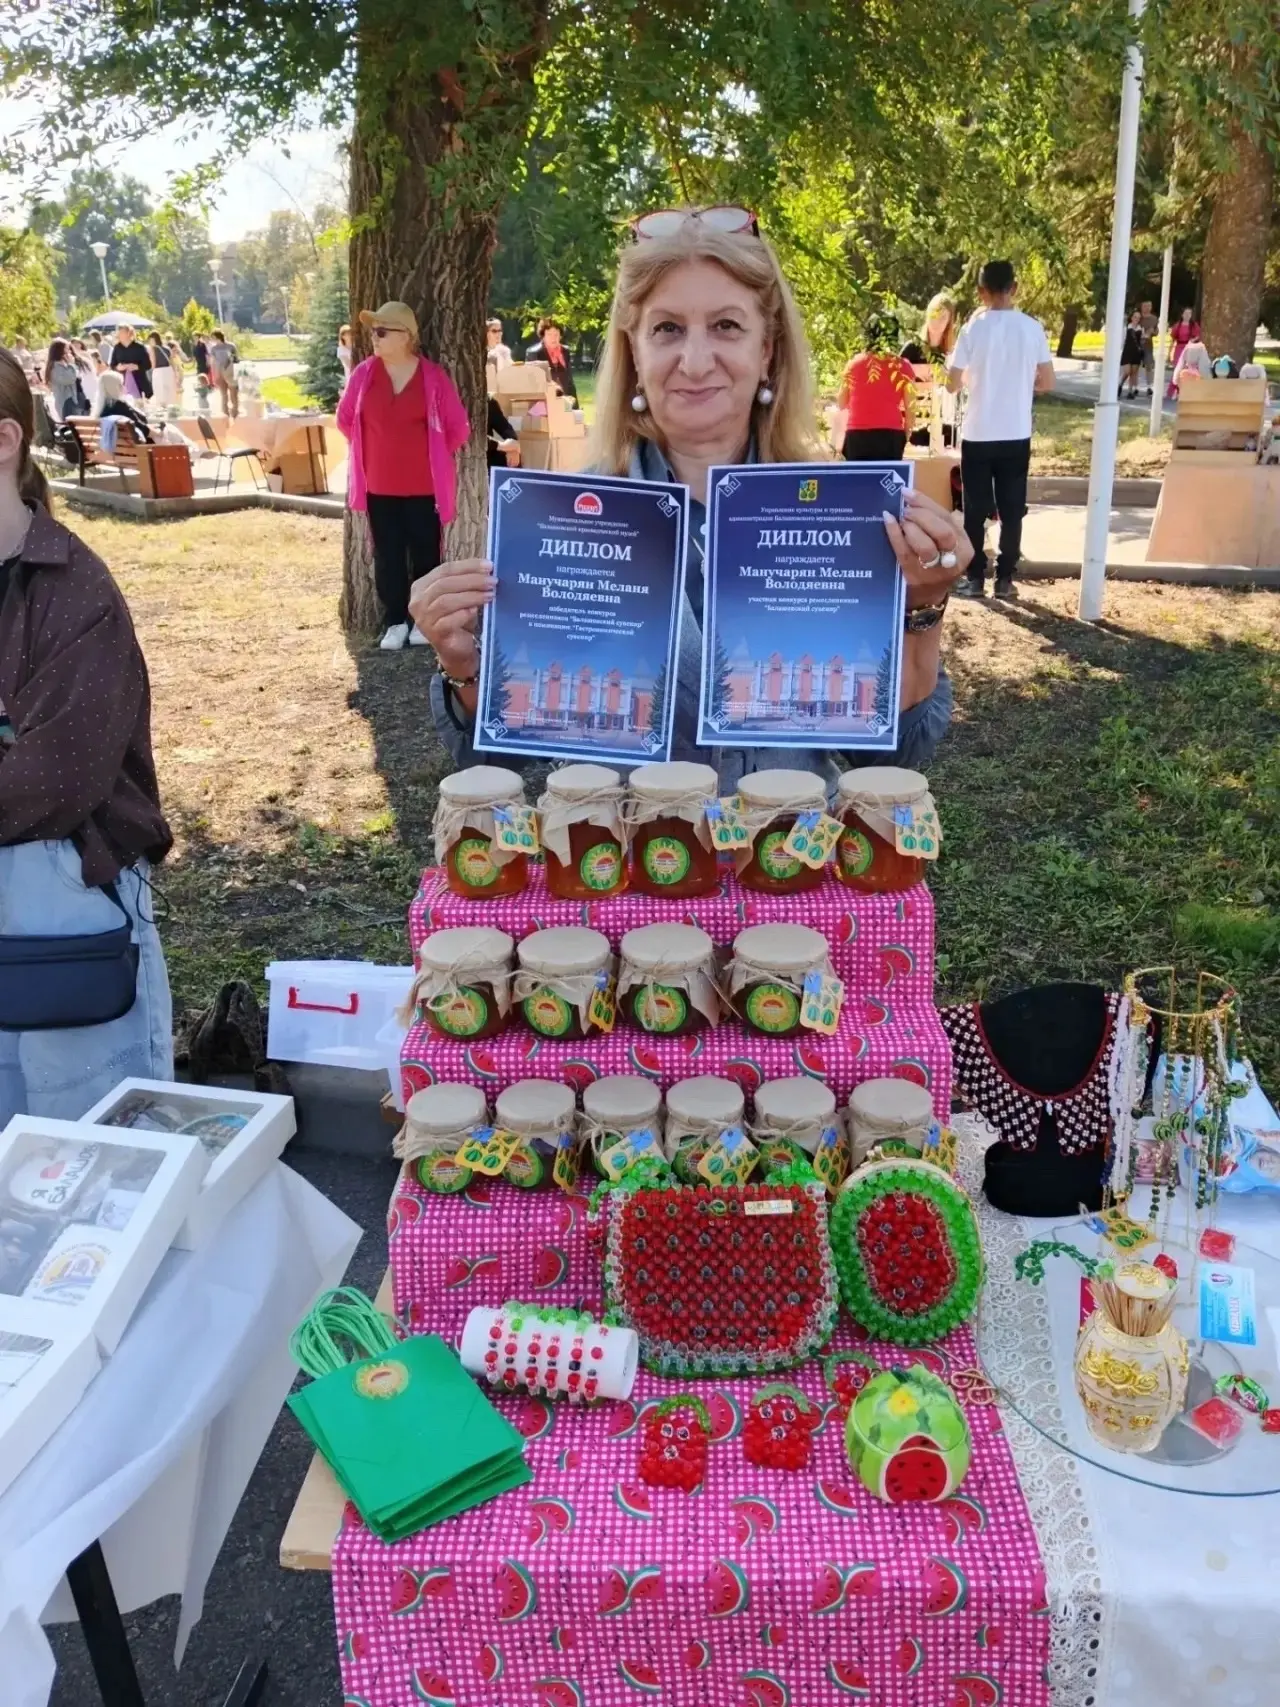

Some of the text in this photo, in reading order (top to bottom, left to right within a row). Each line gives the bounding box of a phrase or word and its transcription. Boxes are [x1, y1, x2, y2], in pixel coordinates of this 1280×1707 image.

[757, 530, 852, 548] ДИПЛОМ
[538, 538, 632, 561] ДИПЛОМ
[775, 556, 836, 565] награждается
[556, 565, 616, 577] награждается
[739, 566, 872, 580] Манучарян Меланя
[518, 572, 649, 594] Манучарян Меланя
[764, 578, 845, 590] Володяевна
[542, 586, 621, 604] Володяевна
